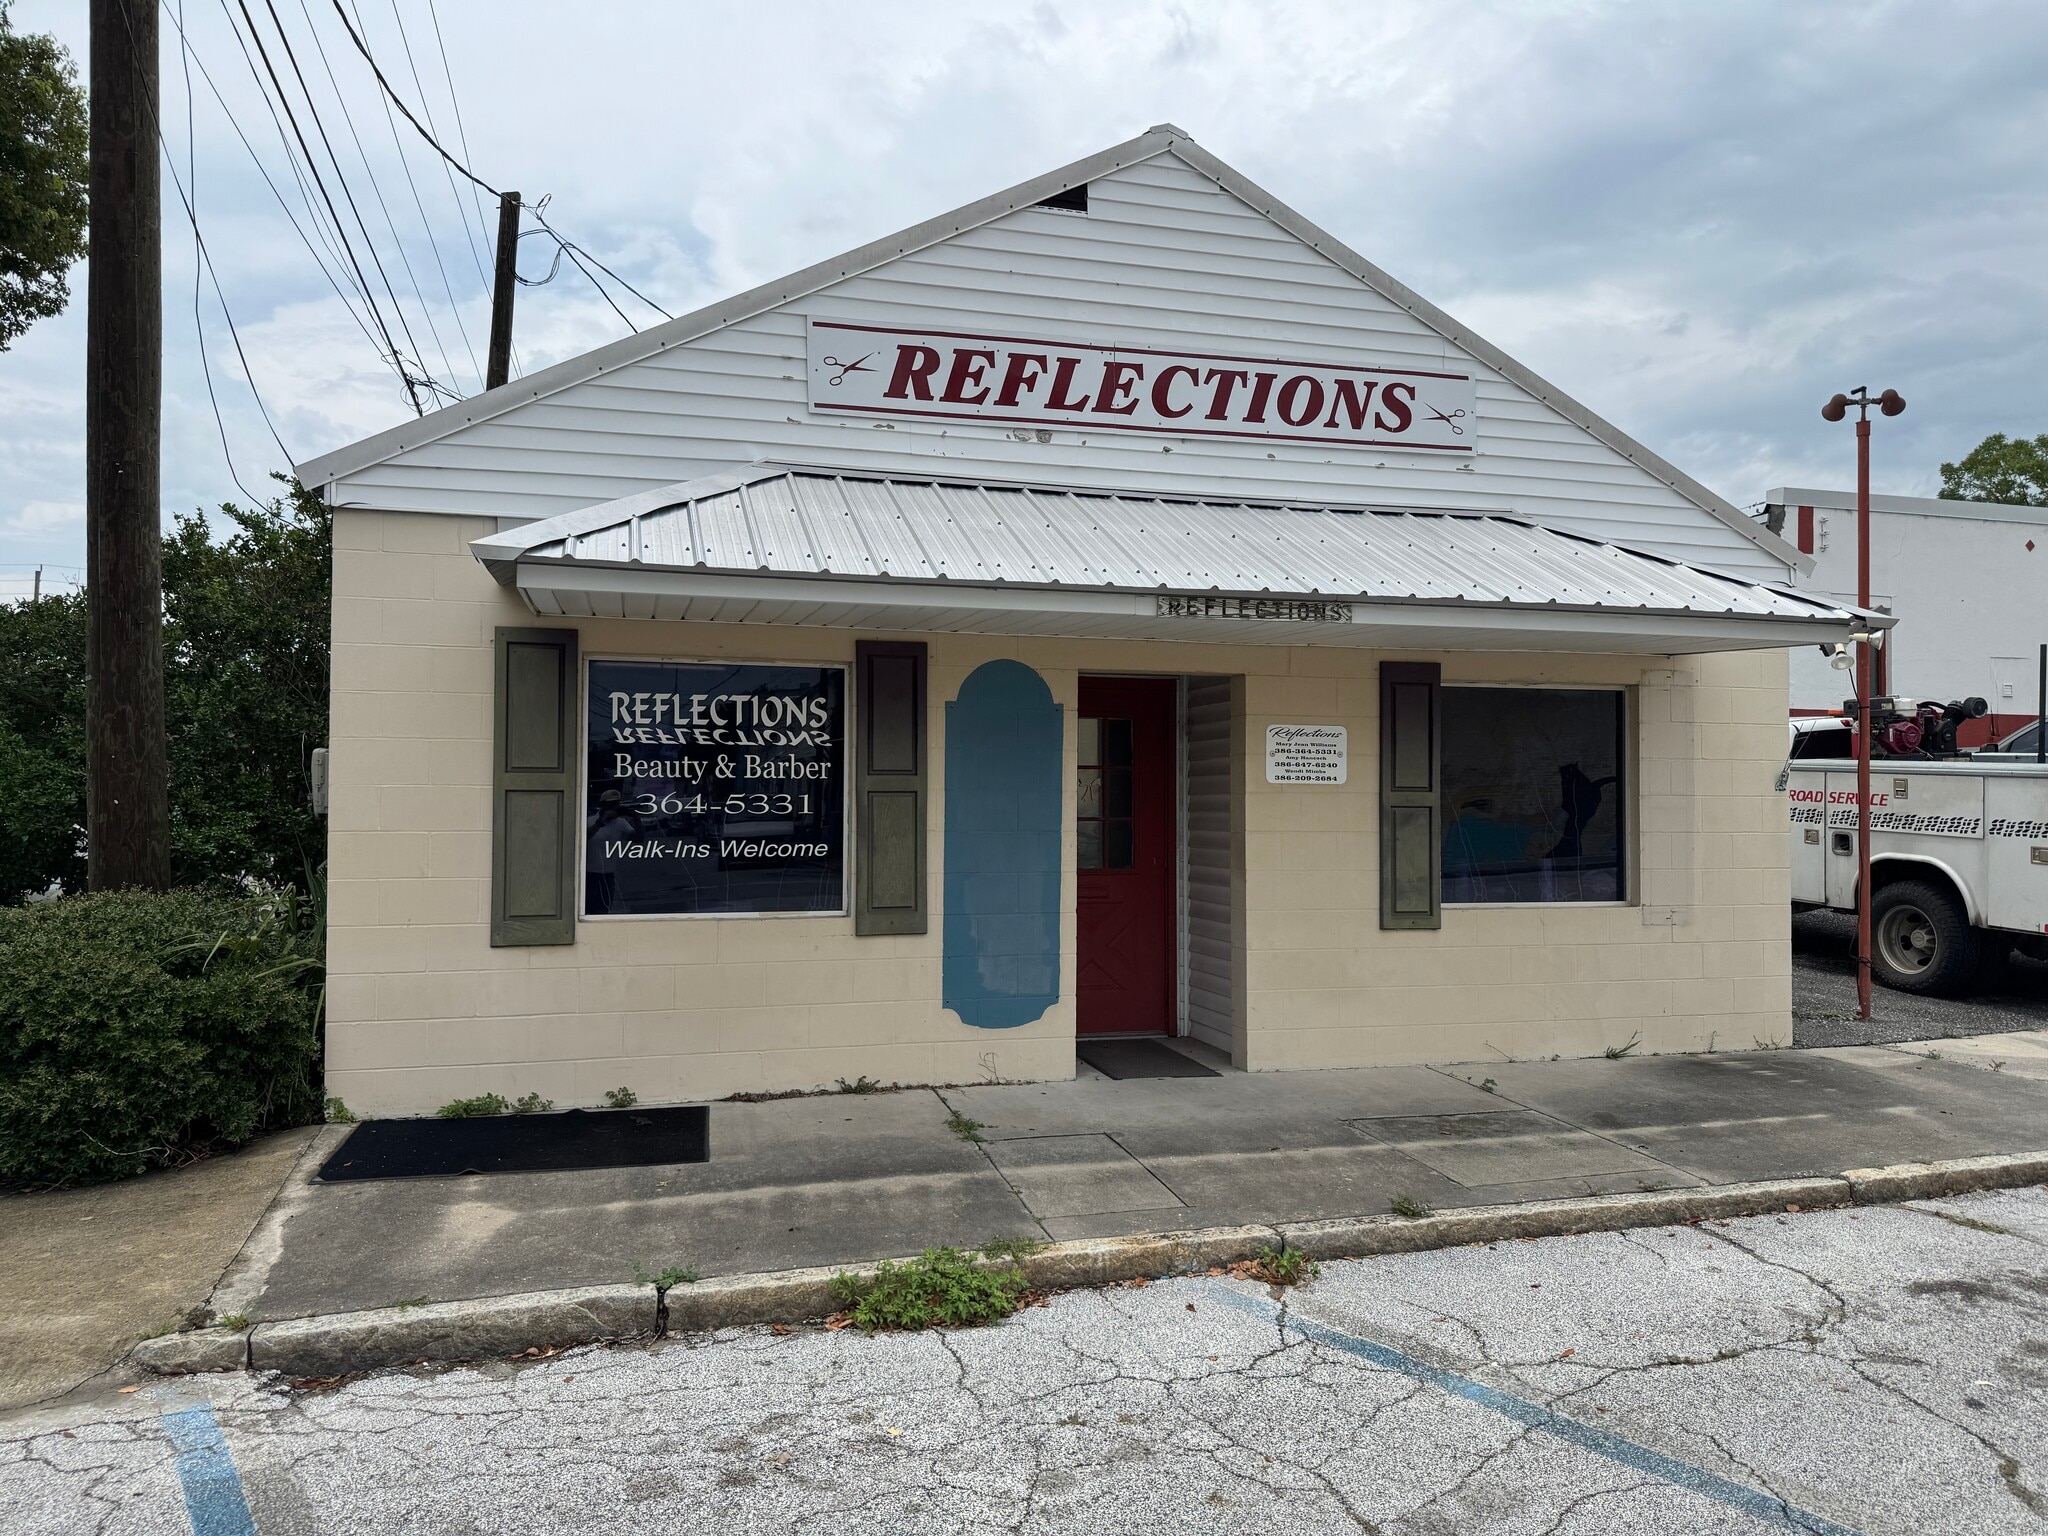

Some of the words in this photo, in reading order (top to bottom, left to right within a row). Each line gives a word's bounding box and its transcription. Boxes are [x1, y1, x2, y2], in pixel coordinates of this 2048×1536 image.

[882, 344, 1416, 433] REFLECTIONS
[1168, 597, 1348, 622] REFLECTIONS
[608, 692, 828, 728] REFLECTIONS
[1269, 726, 1343, 741] Reflections
[613, 753, 708, 784] Beauty
[715, 753, 737, 778] &
[744, 753, 831, 779] Barber
[634, 791, 814, 815] 364-5331
[1789, 790, 1824, 803] ROAD
[1827, 791, 1890, 806] SERCE
[604, 840, 711, 858] Walk-Ins
[719, 839, 829, 858] Welcome
